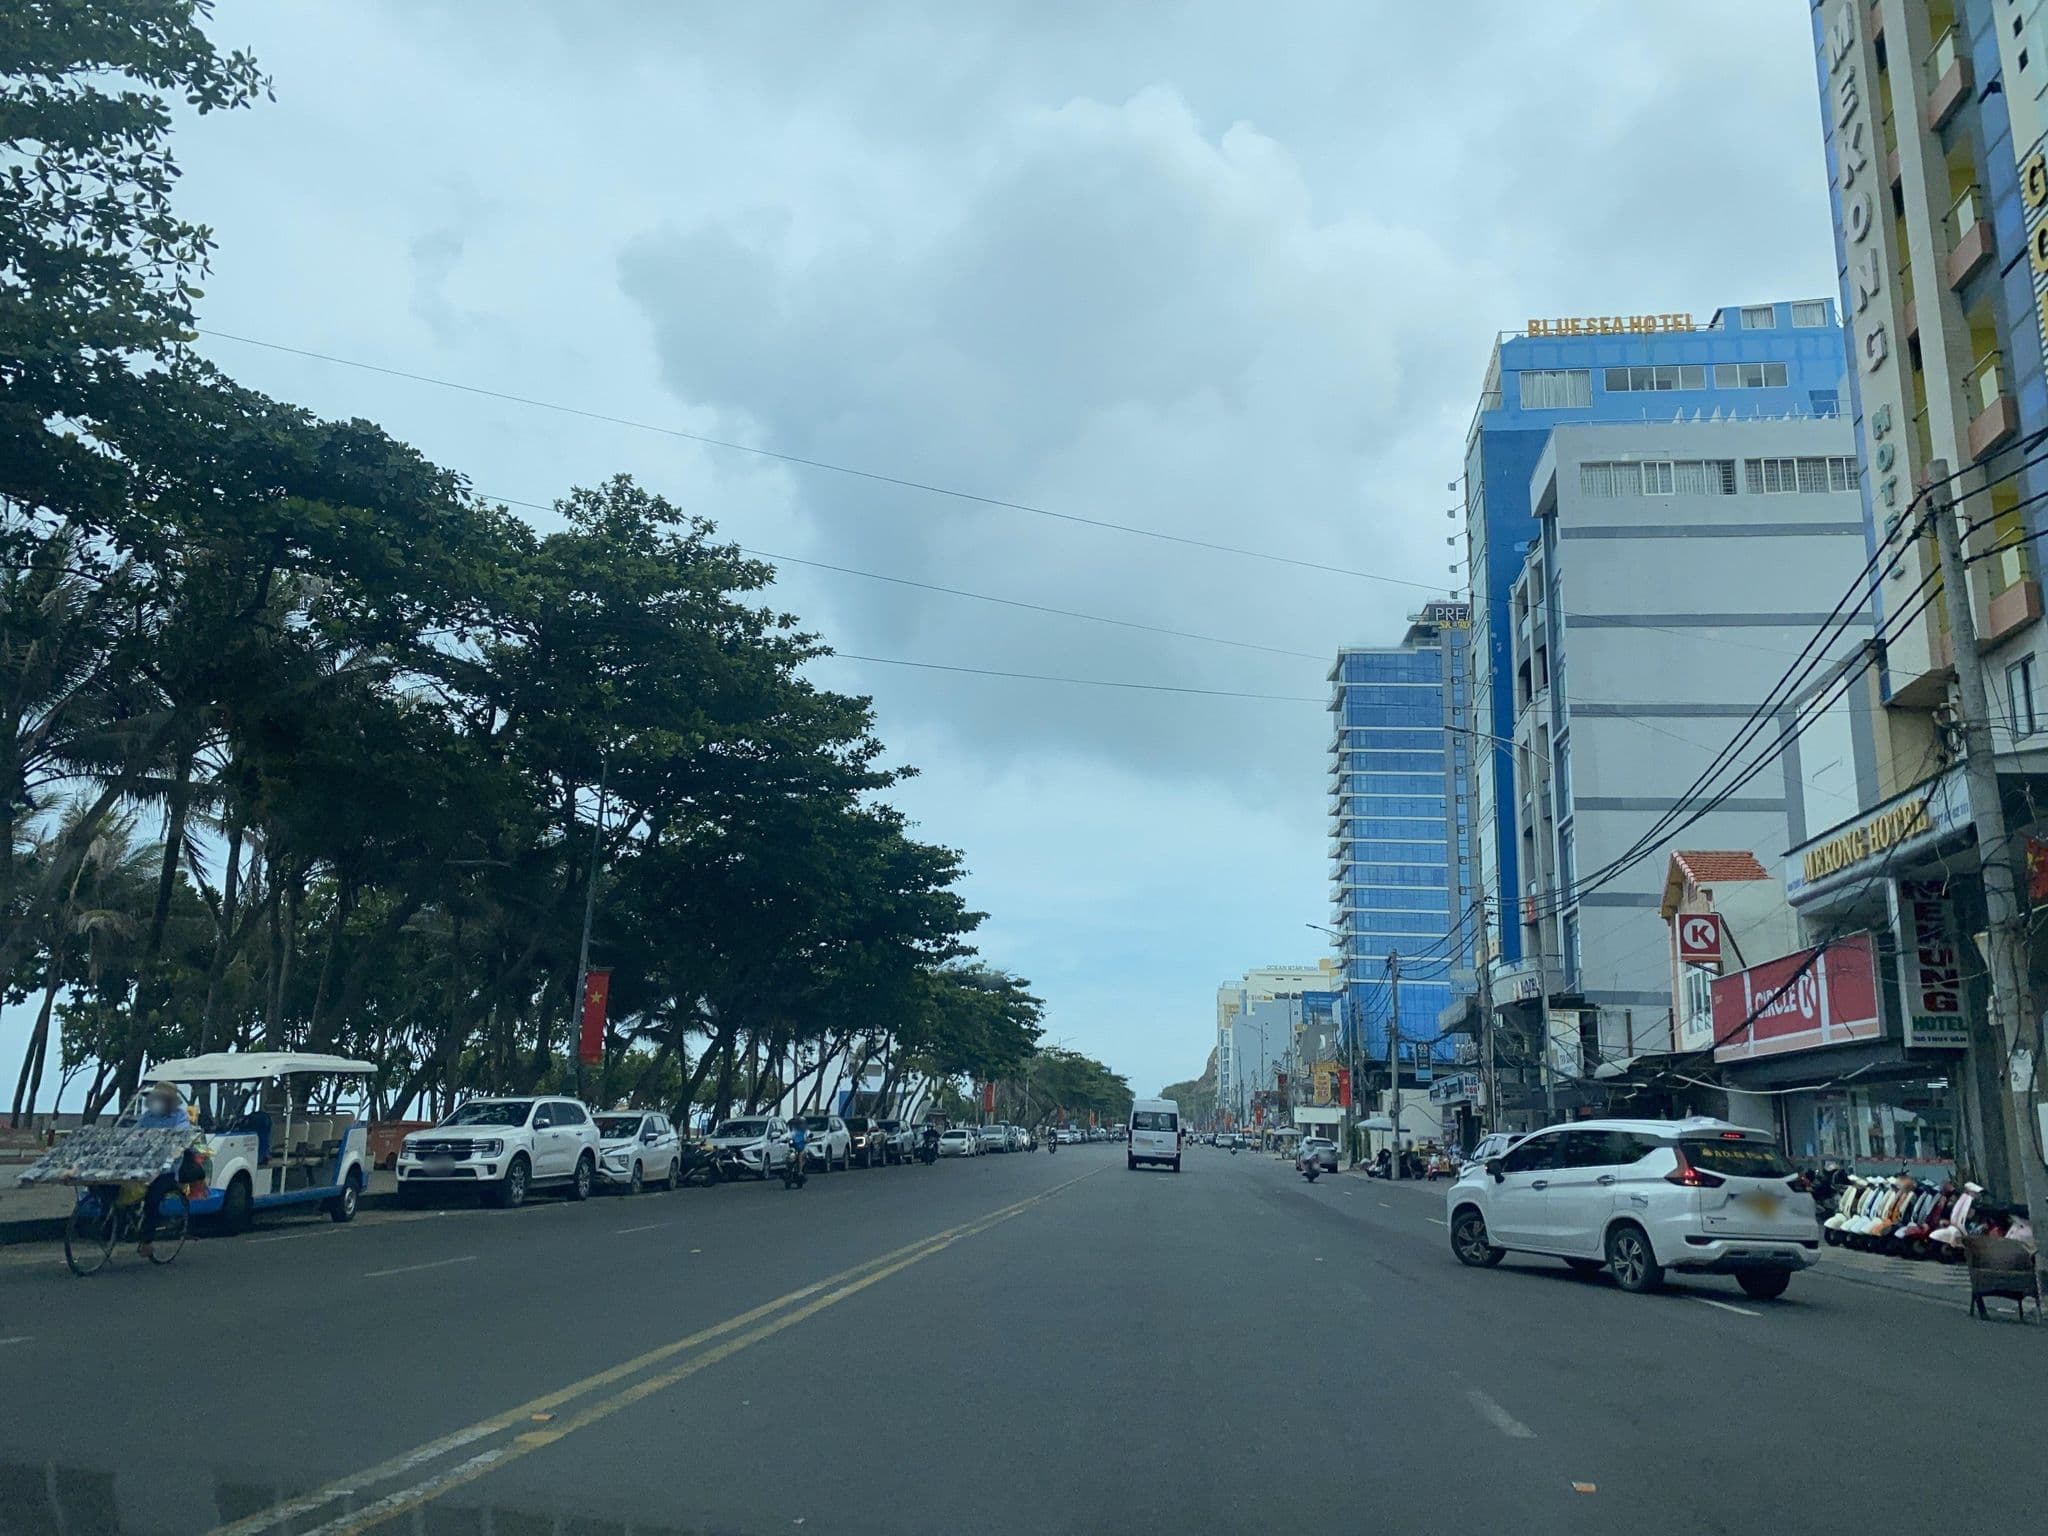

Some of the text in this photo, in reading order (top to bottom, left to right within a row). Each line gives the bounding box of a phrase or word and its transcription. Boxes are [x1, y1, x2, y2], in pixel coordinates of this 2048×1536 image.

[1826, 0, 1889, 375] MEKONG
[1528, 313, 1697, 338] BLUE SEA HOTEL
[1872, 403, 1906, 580] HOTEL
[1803, 798, 1933, 884] MEKONG HOTEL
[1690, 923, 1714, 948] K
[1755, 969, 1817, 1020] CIRCLE K
[1912, 1015, 1968, 1031] HOTEL
